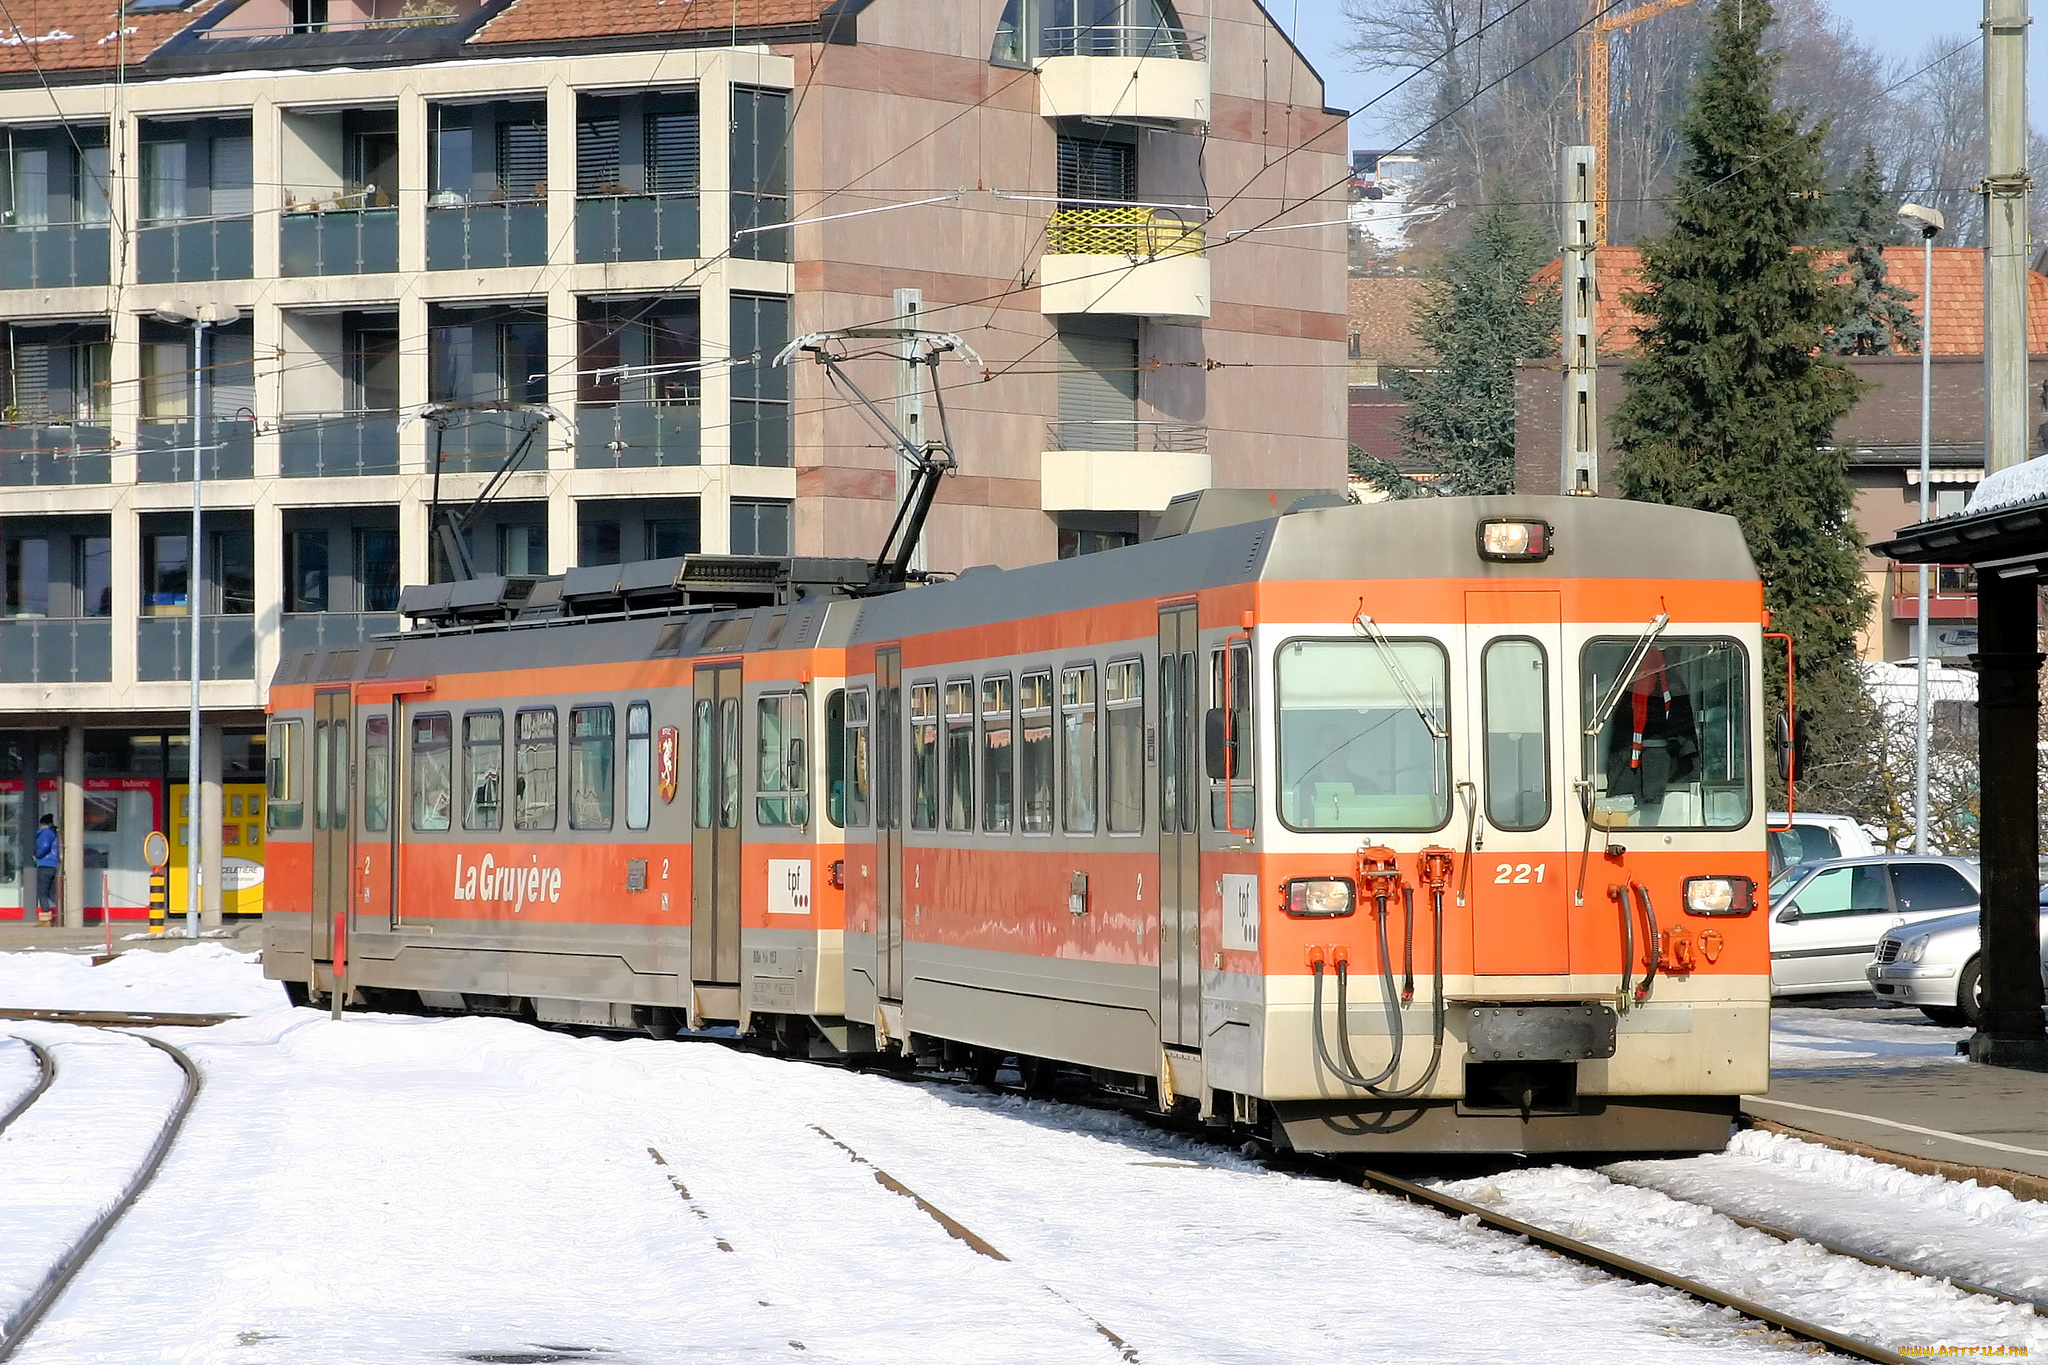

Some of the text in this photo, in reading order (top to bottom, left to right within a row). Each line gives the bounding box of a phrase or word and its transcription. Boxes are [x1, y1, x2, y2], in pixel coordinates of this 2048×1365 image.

[89, 780, 150, 788] Studio Industrie
[364, 855, 371, 875] 2
[662, 858, 669, 879] 2
[915, 864, 920, 888] 2
[1494, 863, 1546, 884] 221
[788, 865, 801, 898] tpf
[1136, 872, 1144, 901] 2
[1238, 882, 1250, 928] tpf
